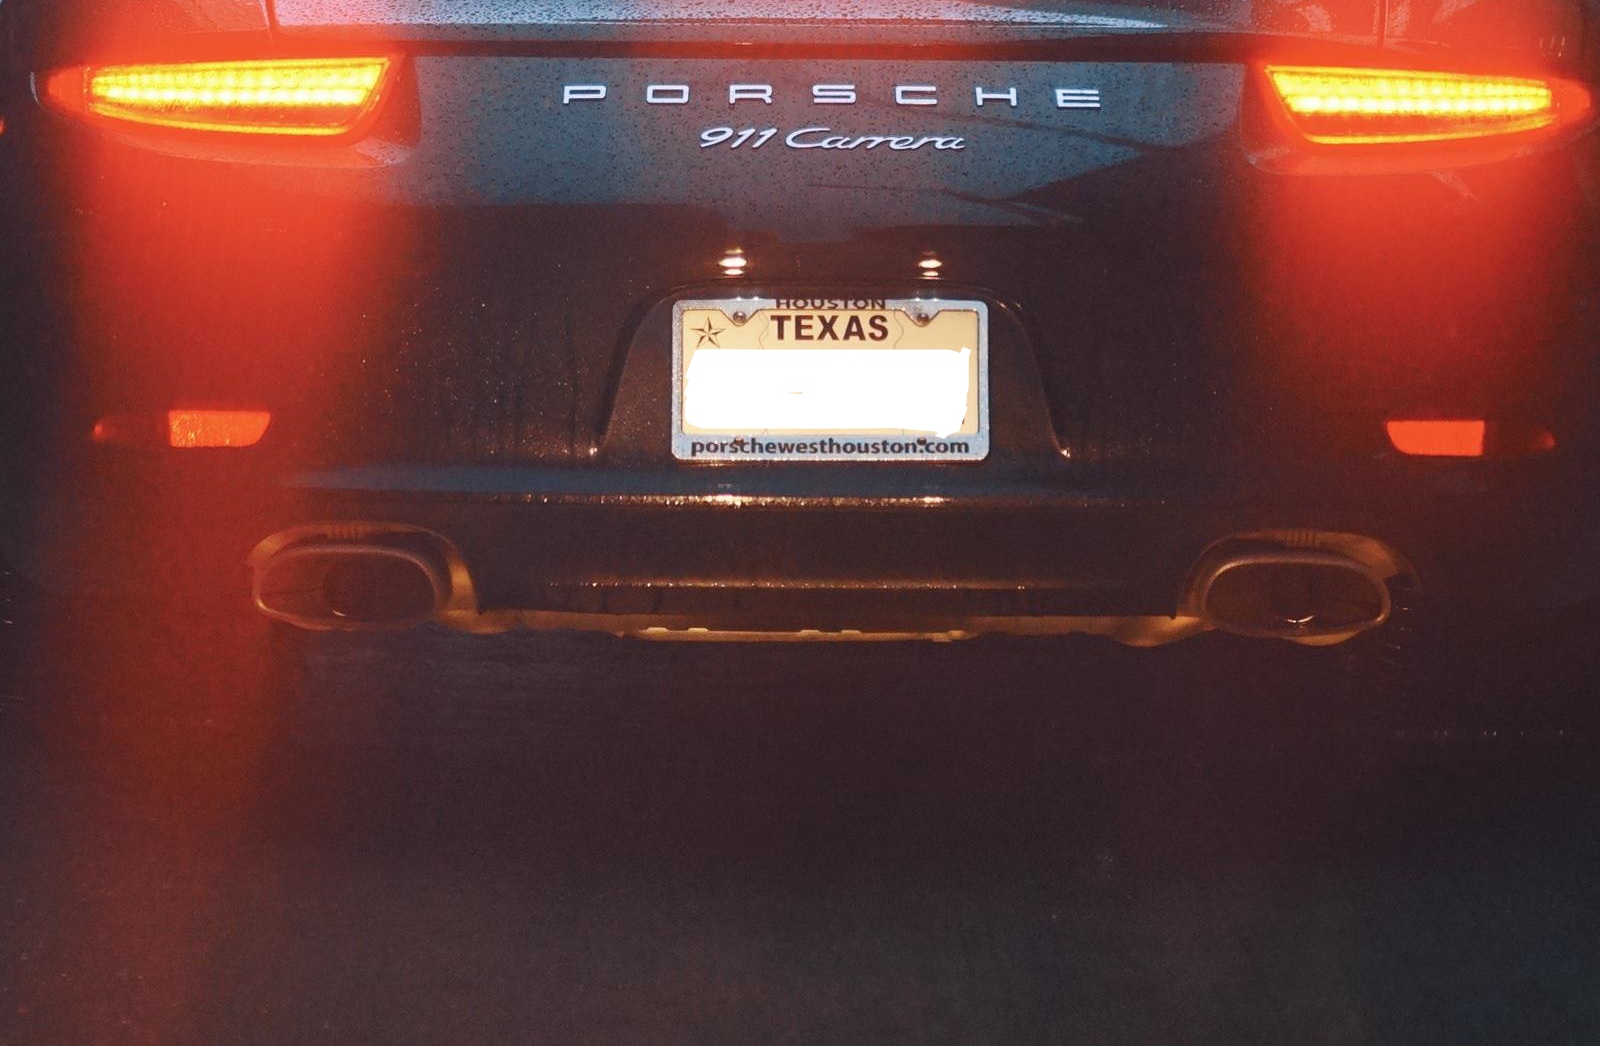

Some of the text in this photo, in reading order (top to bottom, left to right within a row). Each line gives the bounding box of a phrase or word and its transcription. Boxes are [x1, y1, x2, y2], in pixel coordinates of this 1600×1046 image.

[562, 83, 1102, 109] PORSCHE
[700, 126, 966, 150] 911 Carrera
[775, 298, 886, 310] HOUSTON
[770, 314, 889, 341] TEXAS
[691, 437, 970, 456] porschewesthouston.com
